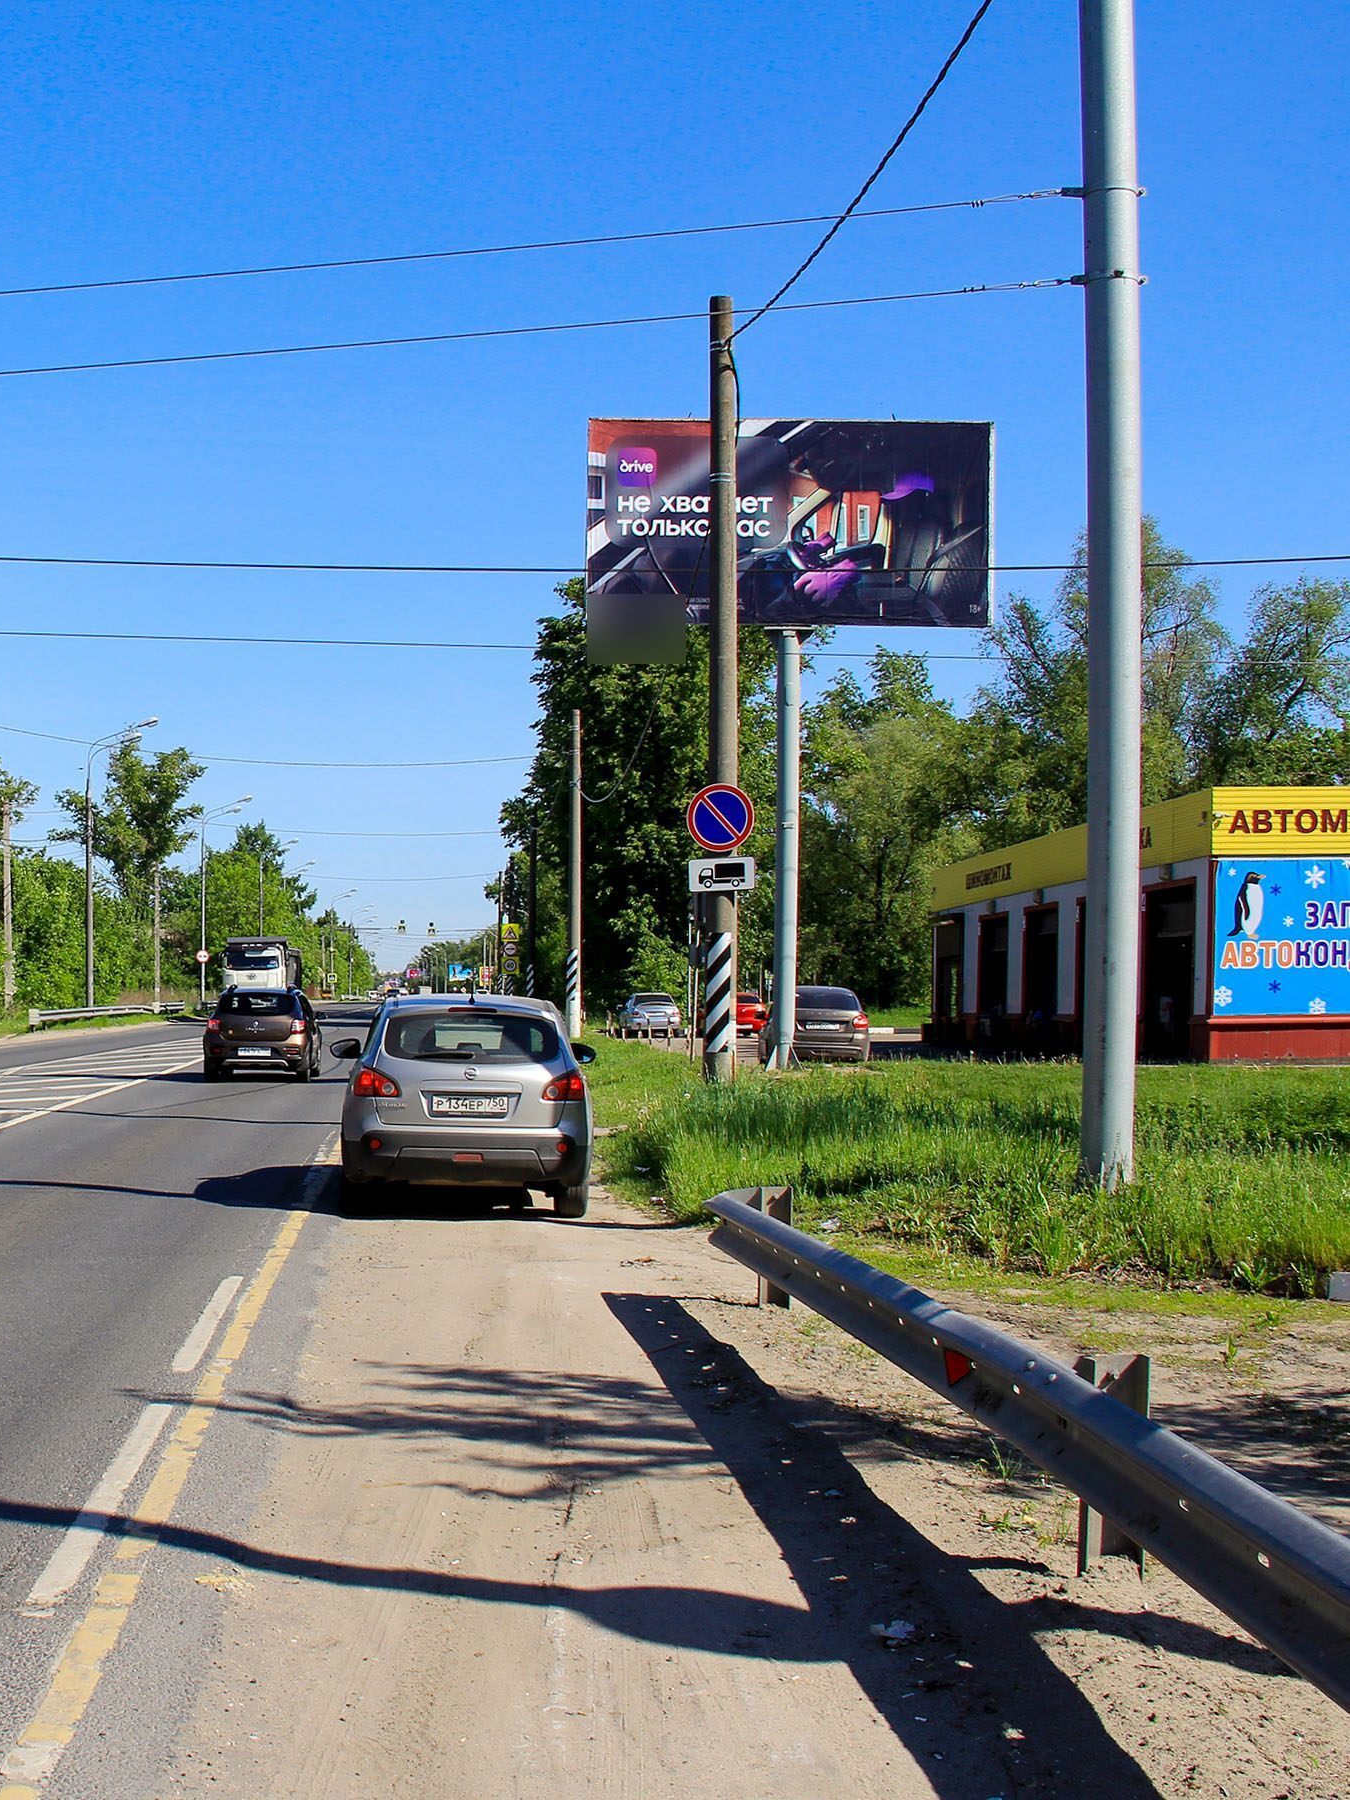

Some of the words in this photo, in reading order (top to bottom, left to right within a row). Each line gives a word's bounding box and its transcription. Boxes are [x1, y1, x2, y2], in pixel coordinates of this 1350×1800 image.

[617, 496, 651, 513] не
[660, 496, 773, 513] хвает
[735, 519, 771, 537] ас
[1228, 809, 1348, 834] АВТОМ
[1221, 941, 1350, 970] АВТОКОН
